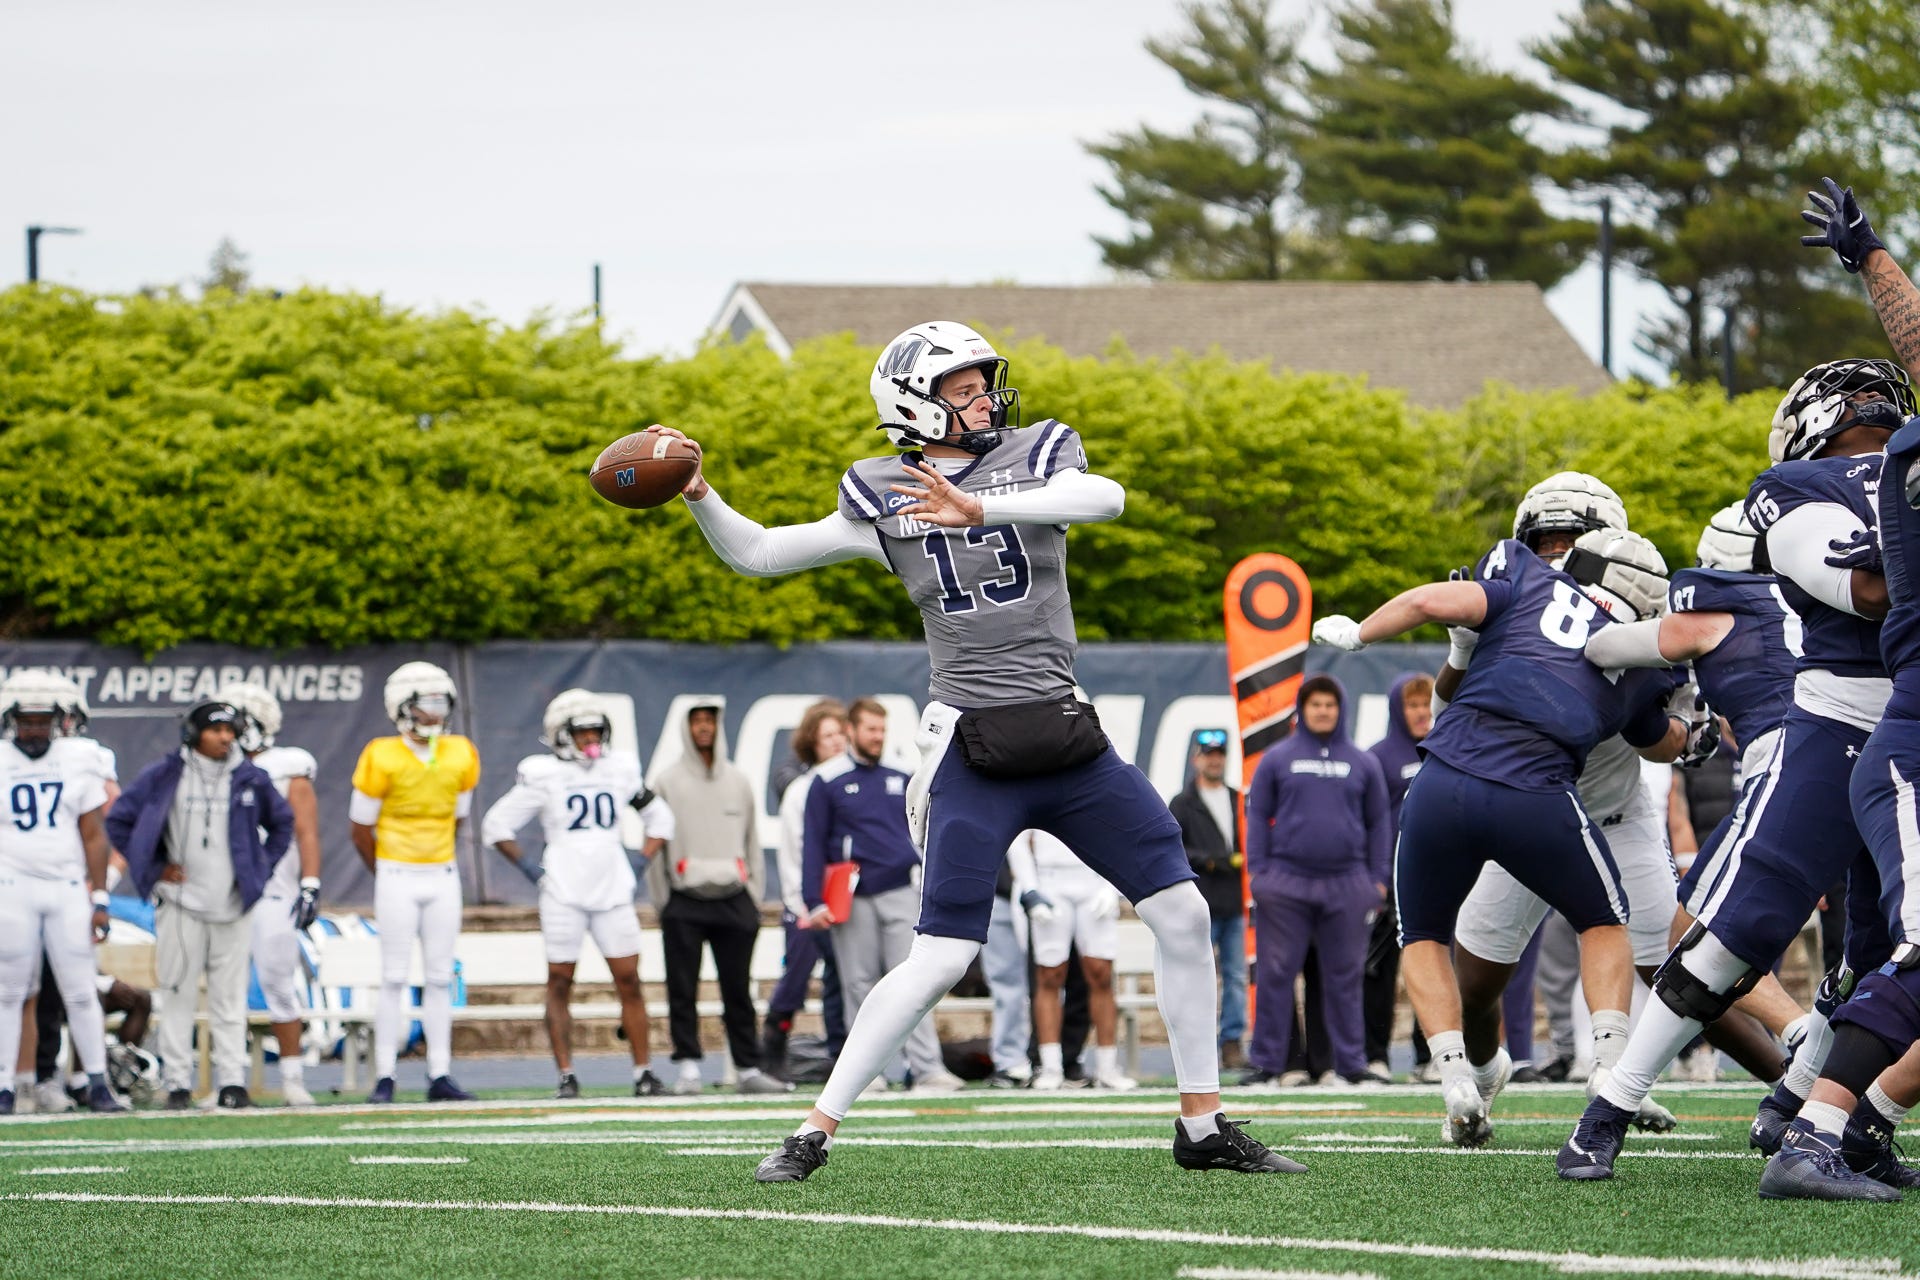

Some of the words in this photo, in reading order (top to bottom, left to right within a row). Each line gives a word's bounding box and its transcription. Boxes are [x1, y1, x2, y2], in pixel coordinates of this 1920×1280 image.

[881, 339, 928, 379] M
[615, 467, 636, 488] M
[1847, 463, 1871, 478] CAA
[1749, 489, 1780, 531] 75
[921, 523, 1033, 615] 13
[1673, 585, 1696, 612] 87
[11, 781, 64, 831] 97
[566, 792, 616, 831] 20
